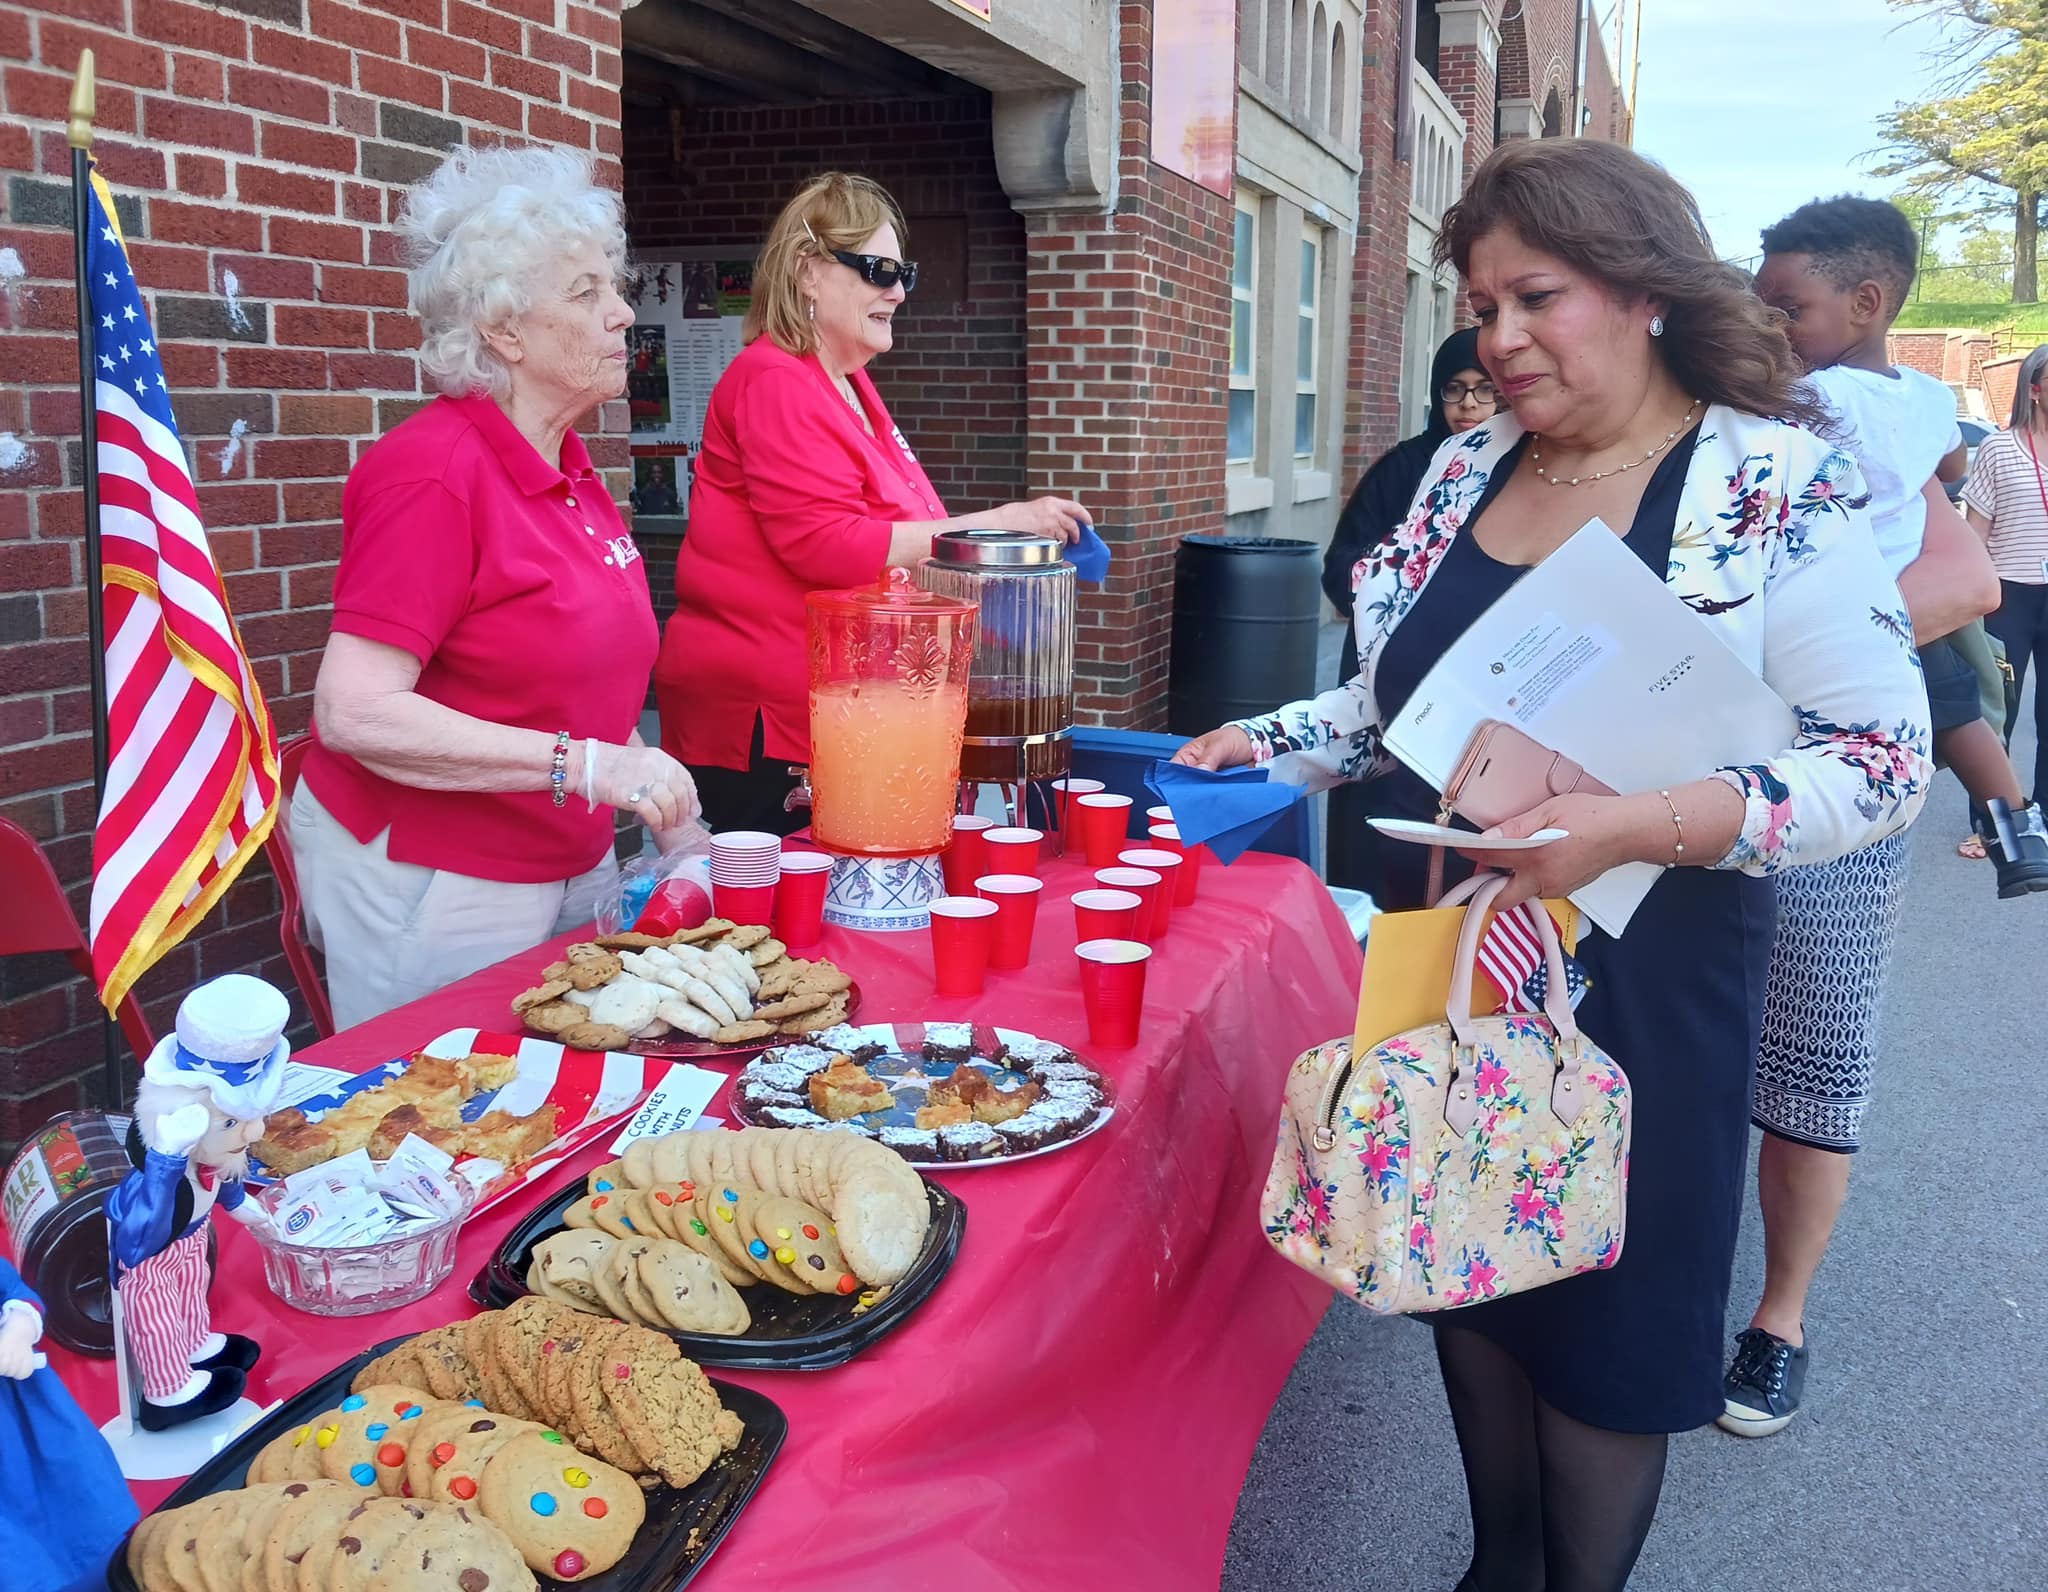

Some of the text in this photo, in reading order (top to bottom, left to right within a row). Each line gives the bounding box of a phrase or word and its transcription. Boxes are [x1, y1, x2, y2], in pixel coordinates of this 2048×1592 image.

[1648, 655, 1692, 692] FIVE STAR
[628, 1092, 667, 1137] COOKIES
[648, 1111, 672, 1135] WITH
[669, 1107, 692, 1131] NUTS
